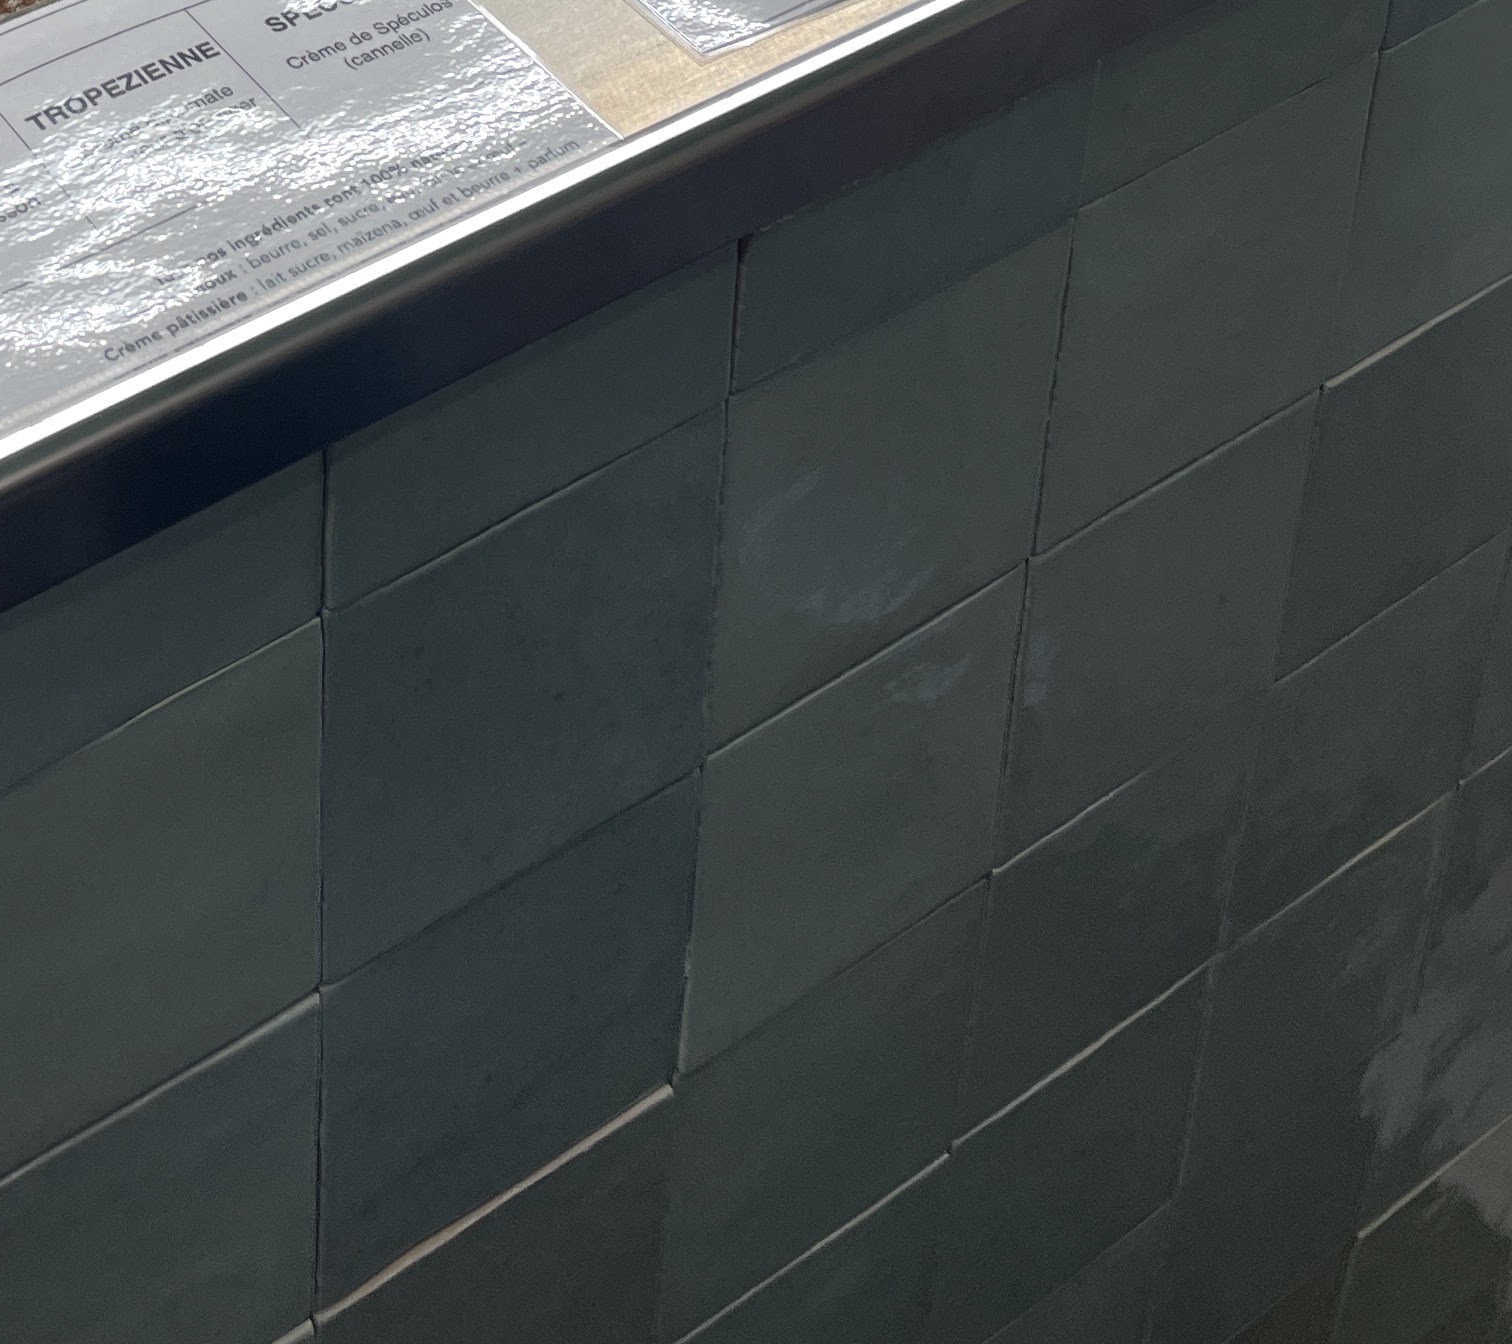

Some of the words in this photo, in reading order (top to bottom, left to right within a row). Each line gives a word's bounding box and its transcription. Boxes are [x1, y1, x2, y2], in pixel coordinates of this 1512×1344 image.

[285, 41, 348, 70] Crème
[349, 30, 373, 47] de
[344, 27, 431, 71] (cannelle)
[24, 40, 221, 131] TROPEZIENNE
[104, 330, 164, 361] Crème
[166, 290, 248, 337] pâtissière
[256, 271, 288, 291] lait
[442, 191, 461, 207] et
[457, 171, 511, 198] beurre
[528, 139, 581, 170] parfum
